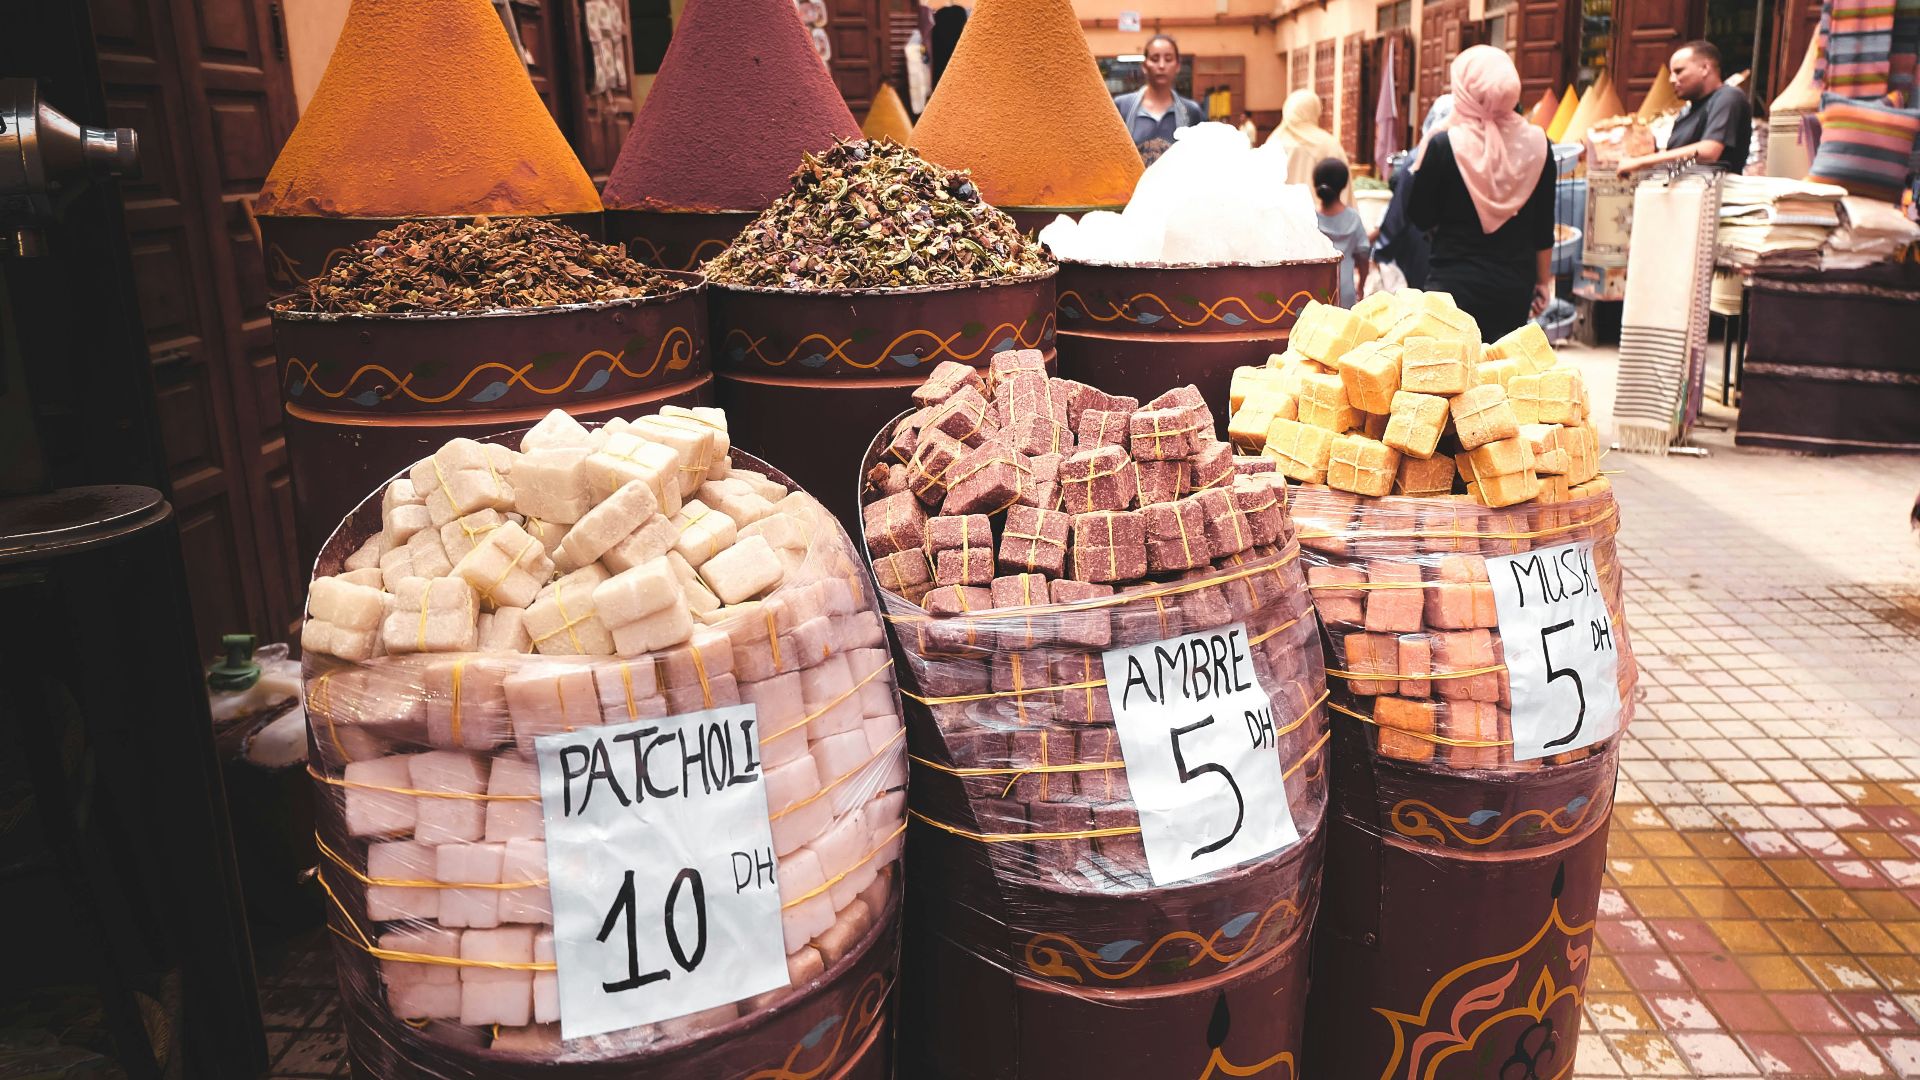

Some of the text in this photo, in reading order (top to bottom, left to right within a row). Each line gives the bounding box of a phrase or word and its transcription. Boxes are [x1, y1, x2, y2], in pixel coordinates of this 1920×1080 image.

[1510, 548, 1597, 607] MUSK
[1123, 630, 1251, 710] AMBRE
[1541, 616, 1612, 749] 5 DH
[560, 720, 760, 816] PATCHOLI
[1171, 708, 1275, 860] 5 DH
[597, 847, 775, 992] 10 DH
